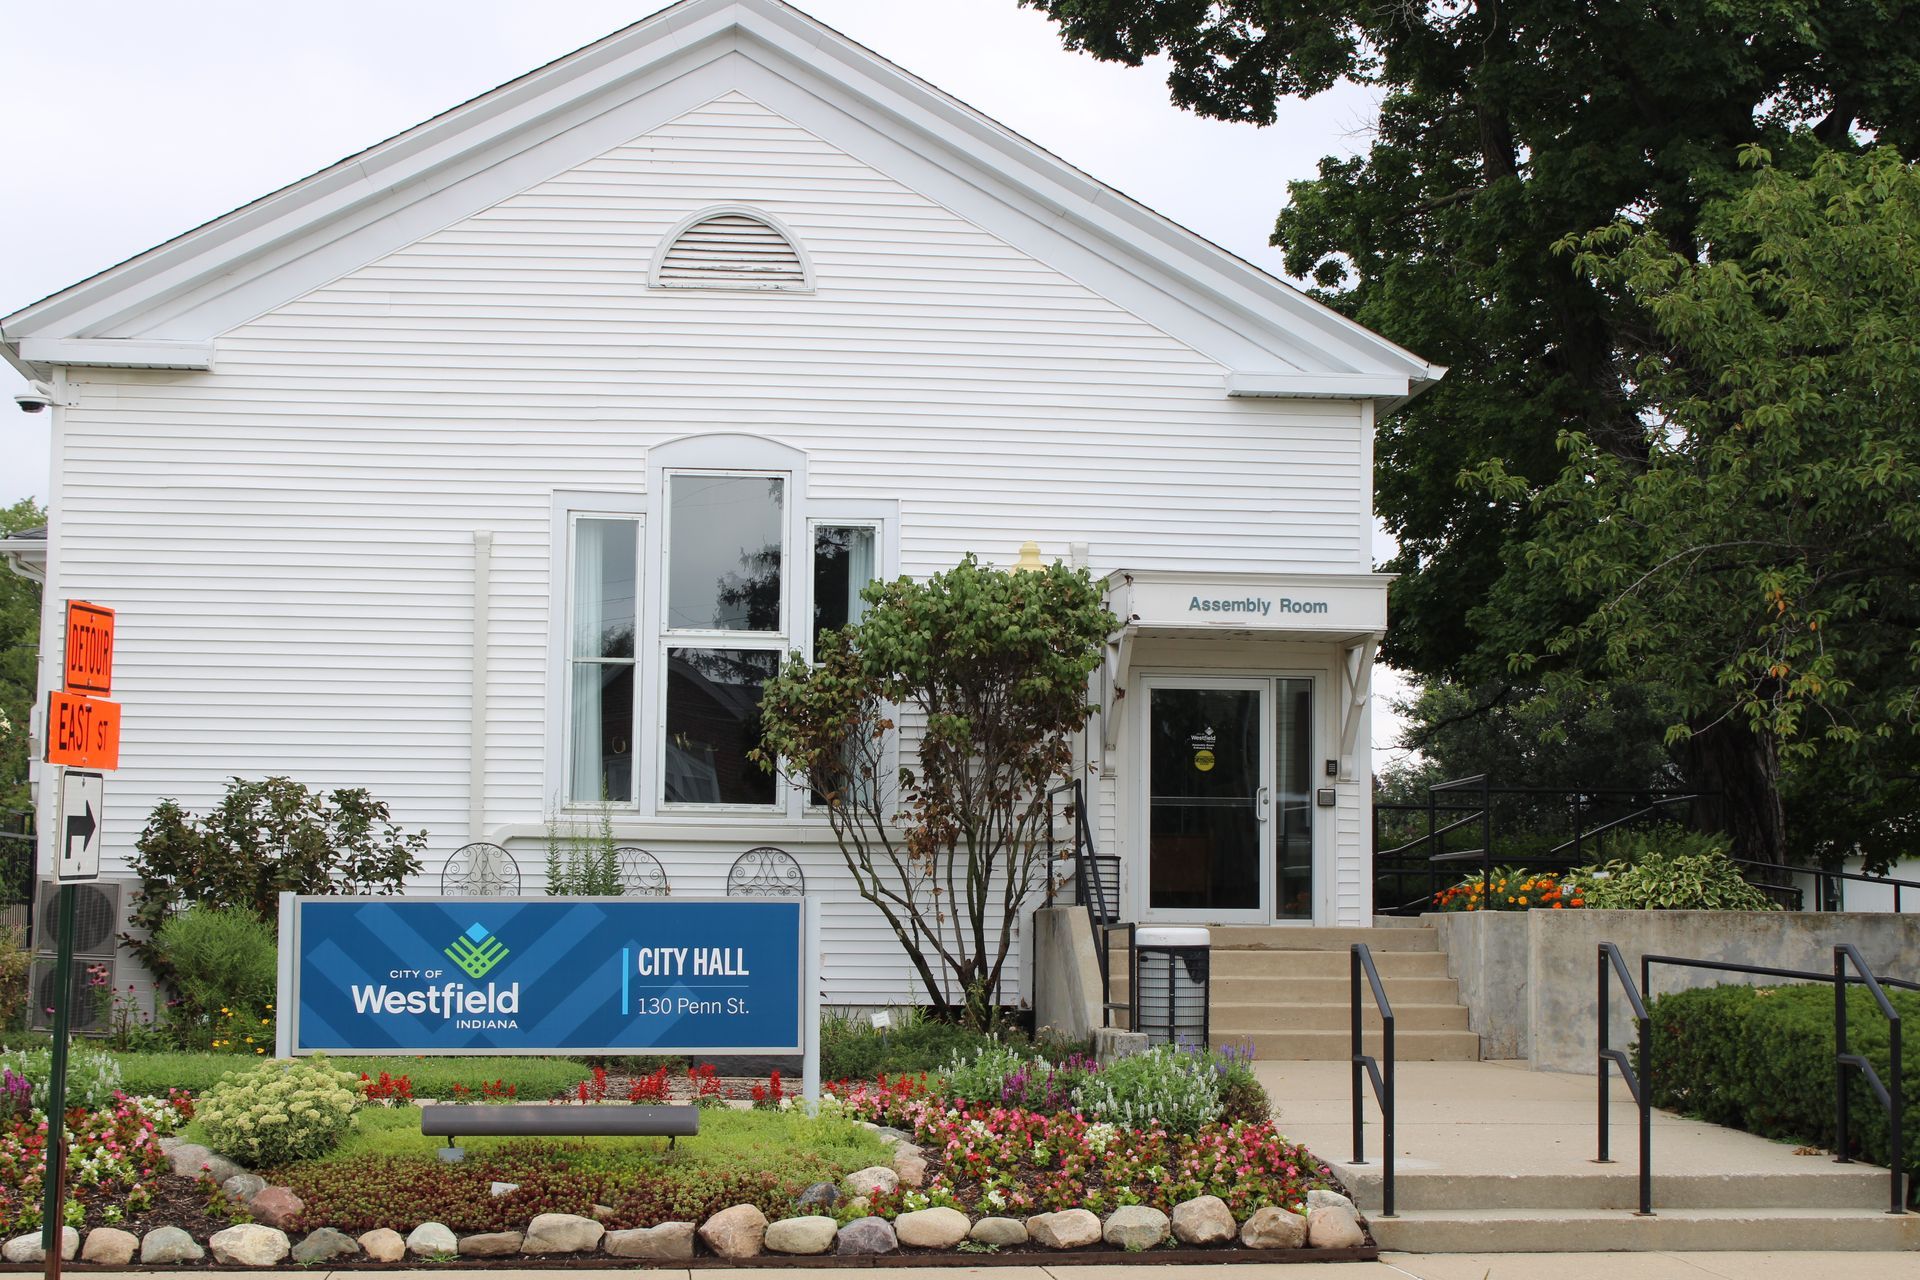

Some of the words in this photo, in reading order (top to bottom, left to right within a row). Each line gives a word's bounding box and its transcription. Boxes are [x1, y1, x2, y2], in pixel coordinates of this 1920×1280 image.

[1189, 596, 1271, 616] Assembly
[1279, 598, 1328, 613] Room
[70, 624, 109, 675] DETOUR
[59, 702, 92, 751] EAST
[97, 721, 108, 751] ST
[390, 970, 420, 978] CITY
[425, 970, 443, 978] OF
[638, 948, 688, 976] CITY
[693, 948, 749, 975] HALL
[351, 982, 519, 1019] Westfield
[639, 998, 672, 1014] 130
[678, 998, 721, 1014] Penn
[727, 998, 749, 1014] St.
[456, 1020, 518, 1029] INDIANA
